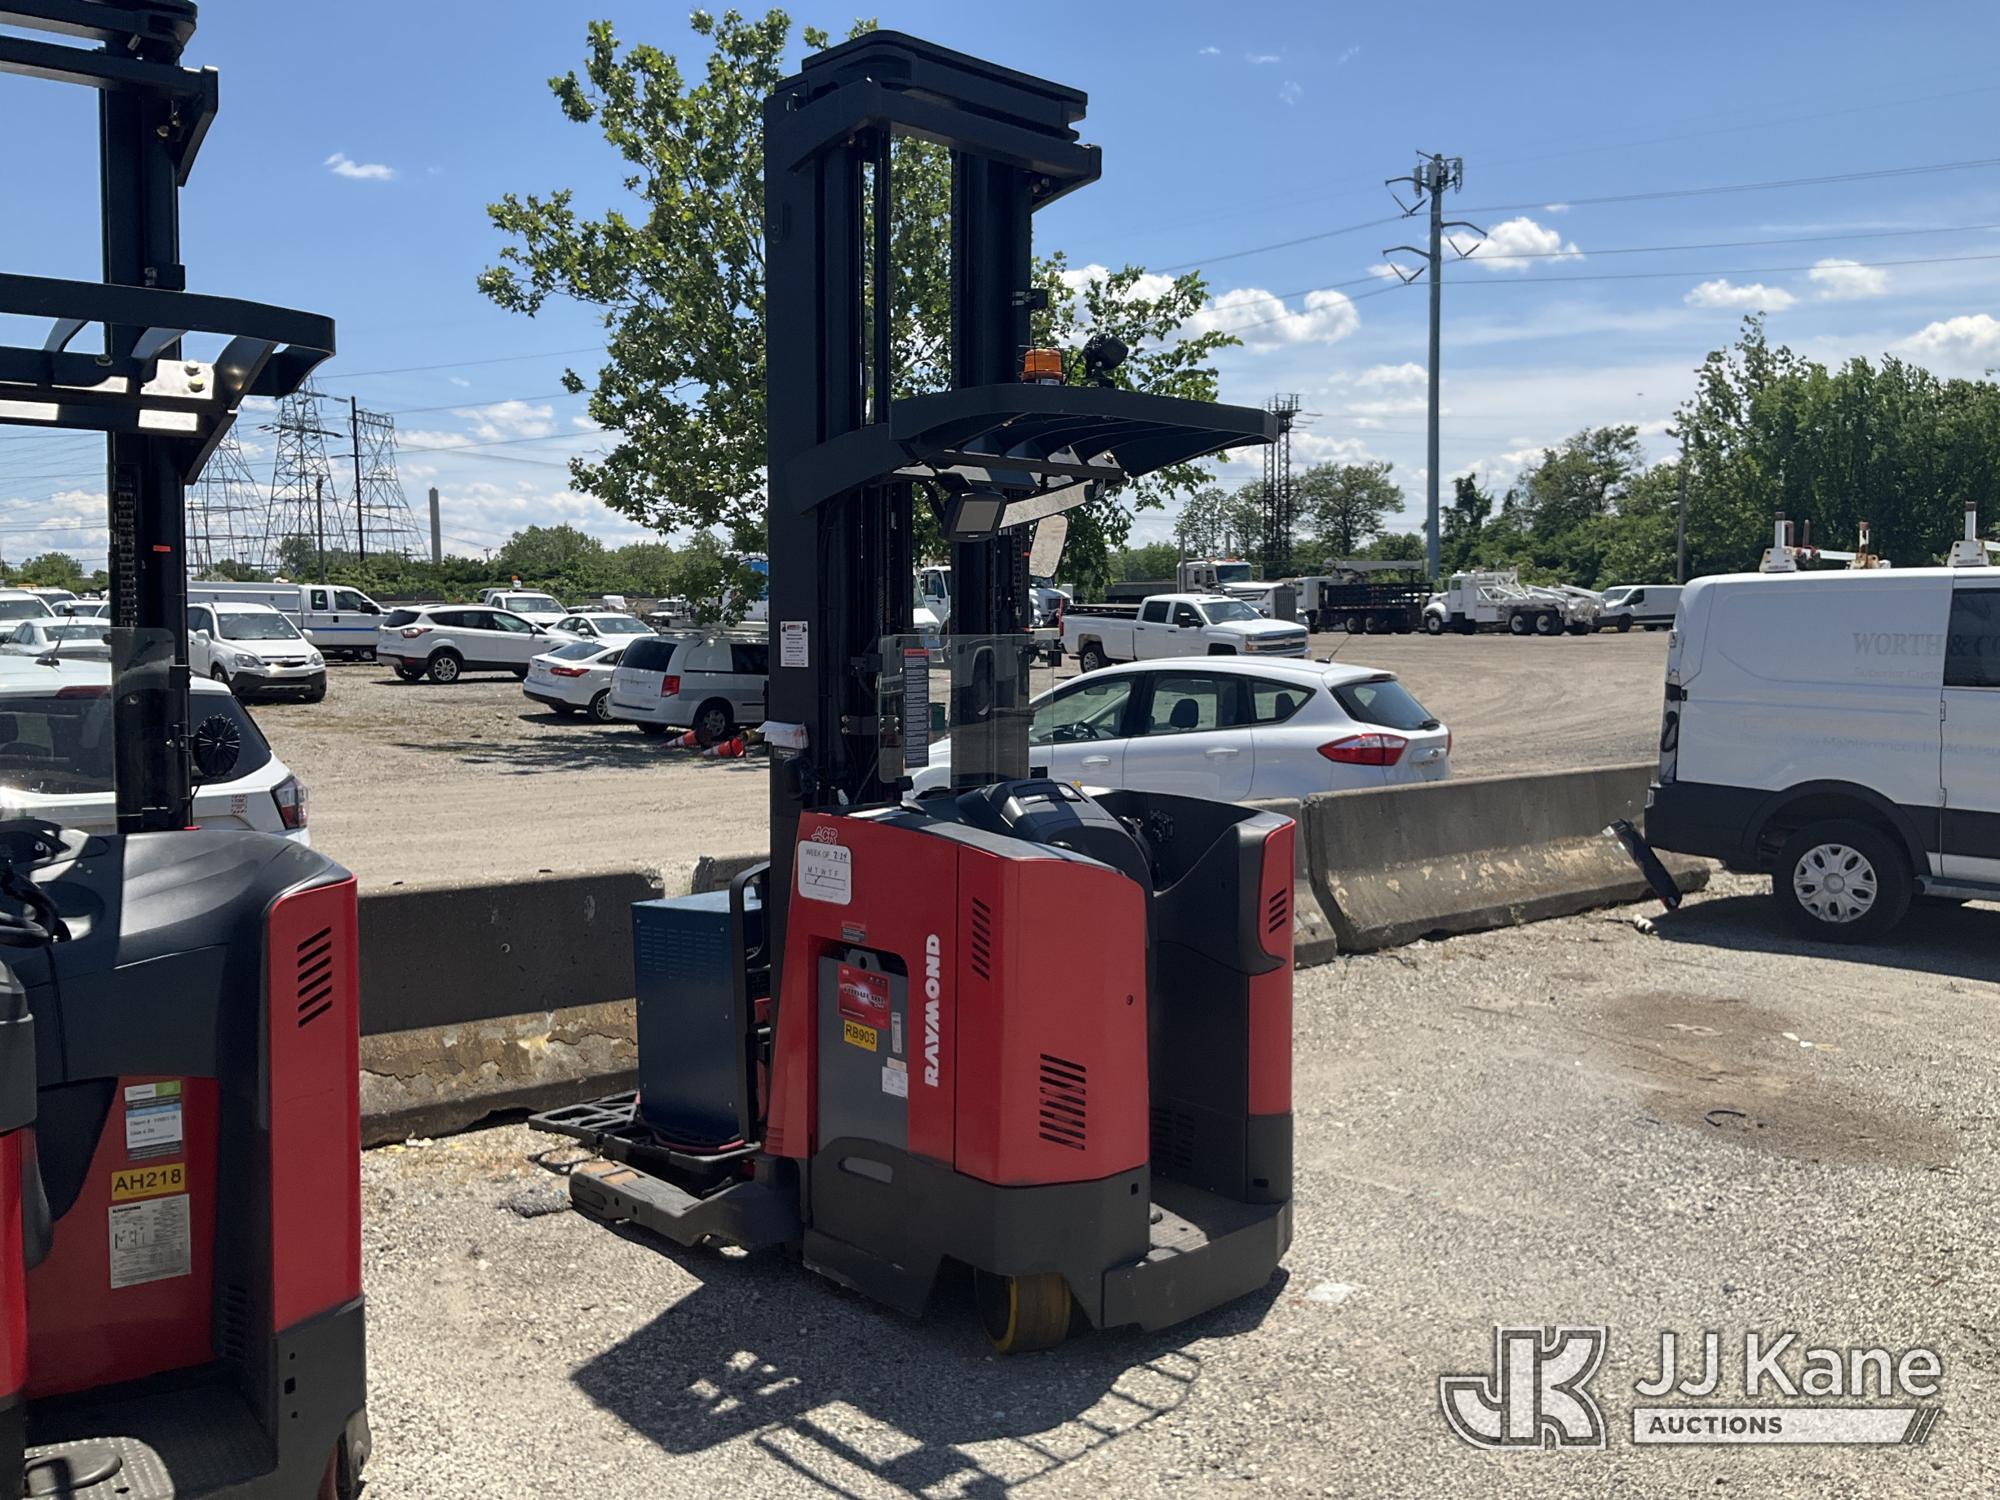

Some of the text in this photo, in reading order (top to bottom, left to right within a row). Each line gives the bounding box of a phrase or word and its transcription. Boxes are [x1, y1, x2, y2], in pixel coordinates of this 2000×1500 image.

[1852, 632, 1942, 657] WORTH
[1953, 634, 1969, 657] &
[925, 934, 940, 1087] RAYMOND
[845, 1023, 876, 1045] RB903
[114, 1168, 182, 1192] AH218
